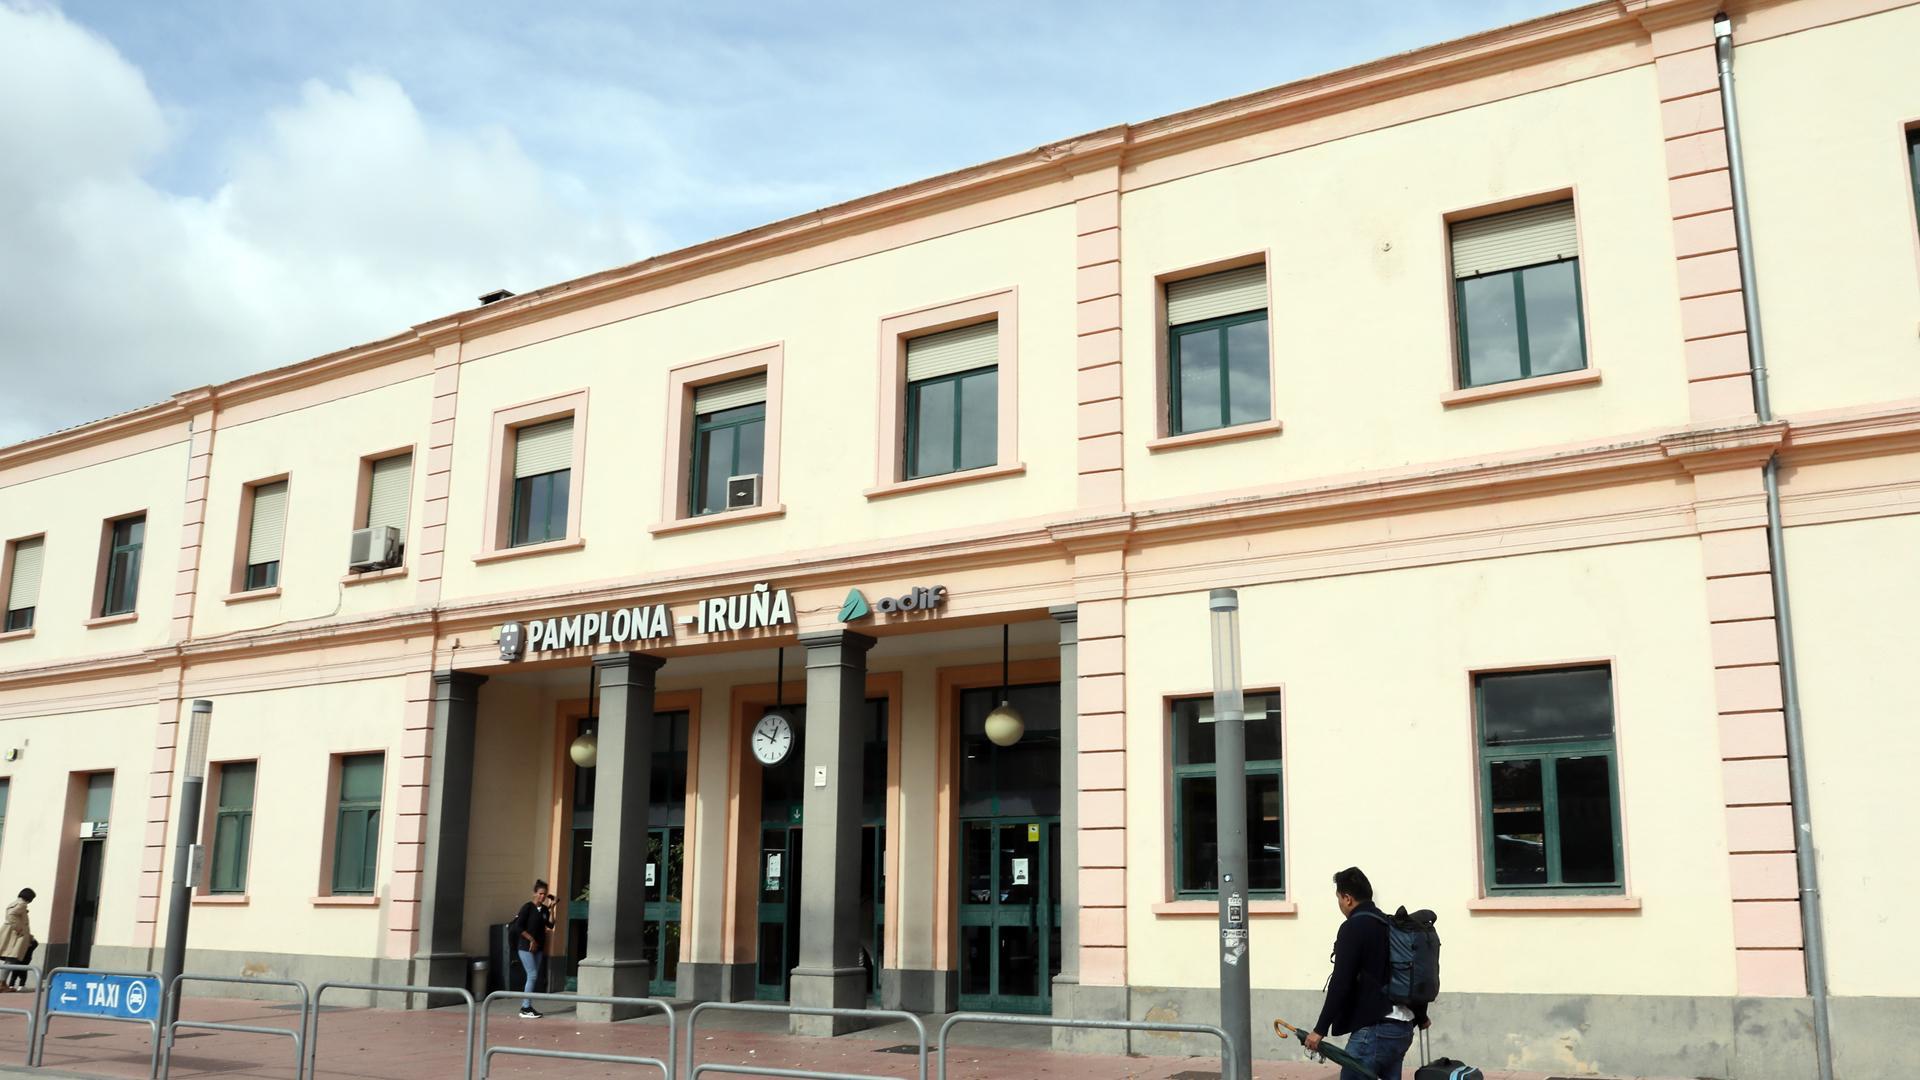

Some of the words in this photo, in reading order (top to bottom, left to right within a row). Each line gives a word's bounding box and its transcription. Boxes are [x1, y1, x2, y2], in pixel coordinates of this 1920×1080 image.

[876, 585, 947, 613] adif
[527, 604, 669, 652] PAMPLONA
[86, 982, 119, 1008] TAXI
